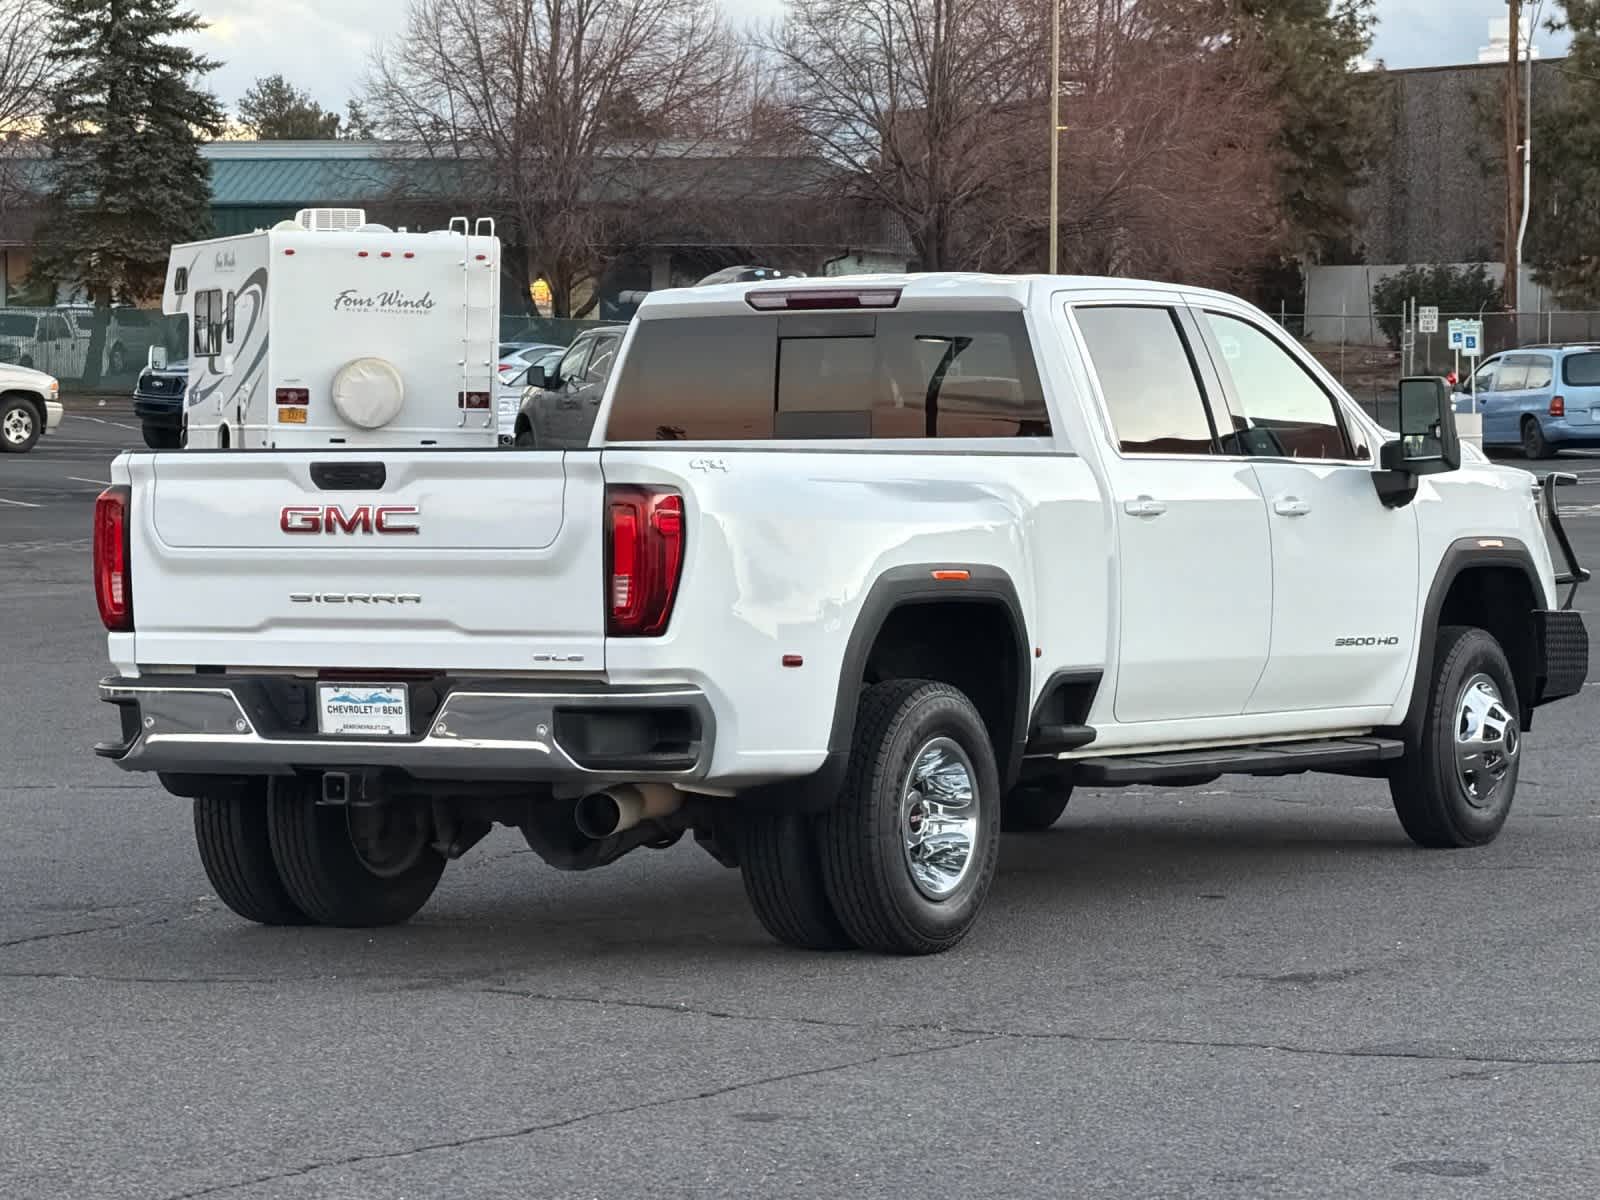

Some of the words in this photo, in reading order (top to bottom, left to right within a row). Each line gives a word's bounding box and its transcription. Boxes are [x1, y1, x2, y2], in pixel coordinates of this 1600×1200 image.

[334, 289, 374, 311] Four
[377, 289, 436, 309] Winds
[280, 505, 420, 535] GMC
[289, 593, 422, 604] SIERRA
[1335, 638, 1375, 646] 3500
[1377, 637, 1399, 645] HD
[327, 705, 373, 714] CHEVROLET
[382, 705, 404, 715] BEND
